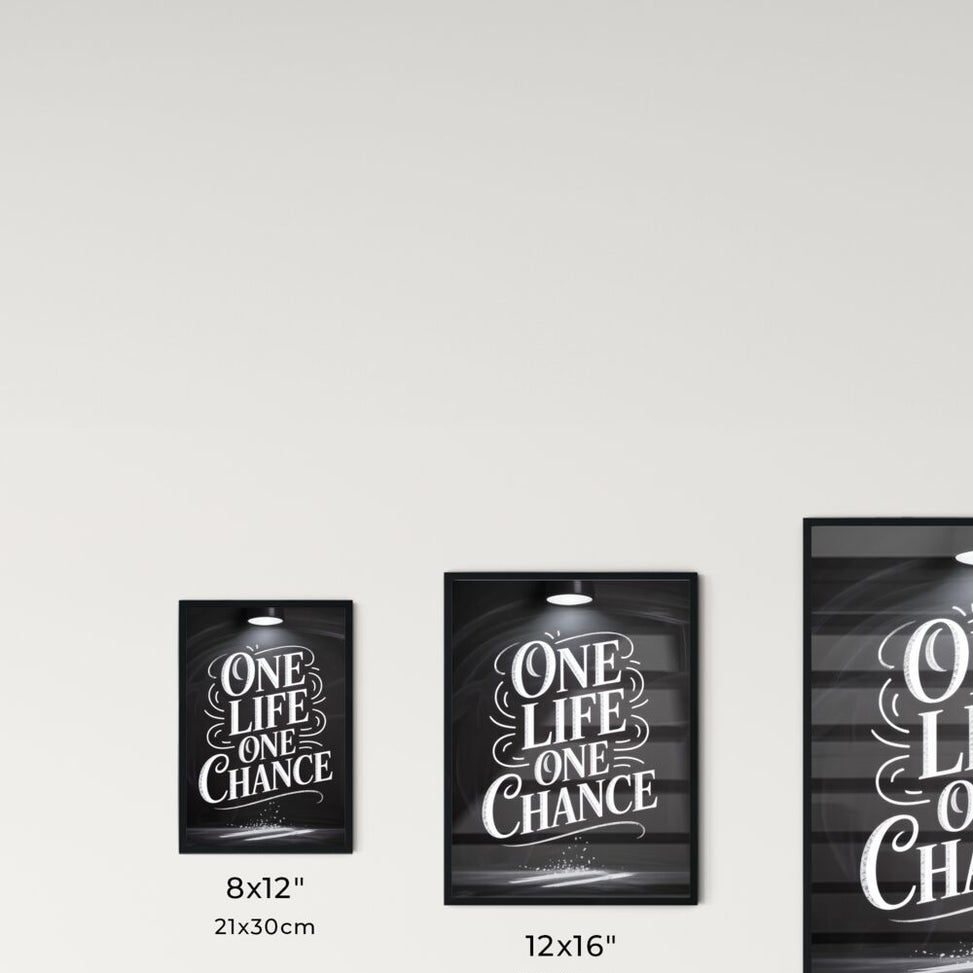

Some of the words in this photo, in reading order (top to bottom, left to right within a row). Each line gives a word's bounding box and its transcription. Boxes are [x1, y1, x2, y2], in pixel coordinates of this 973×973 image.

[220, 651, 306, 697] ONE
[511, 639, 622, 699] ONE
[229, 688, 309, 736] LIFE
[521, 687, 627, 751] LIFE
[238, 728, 297, 764] ONE
[534, 740, 610, 786] ONE
[198, 750, 333, 804] CHANCE
[481, 769, 658, 839] CHANCE
